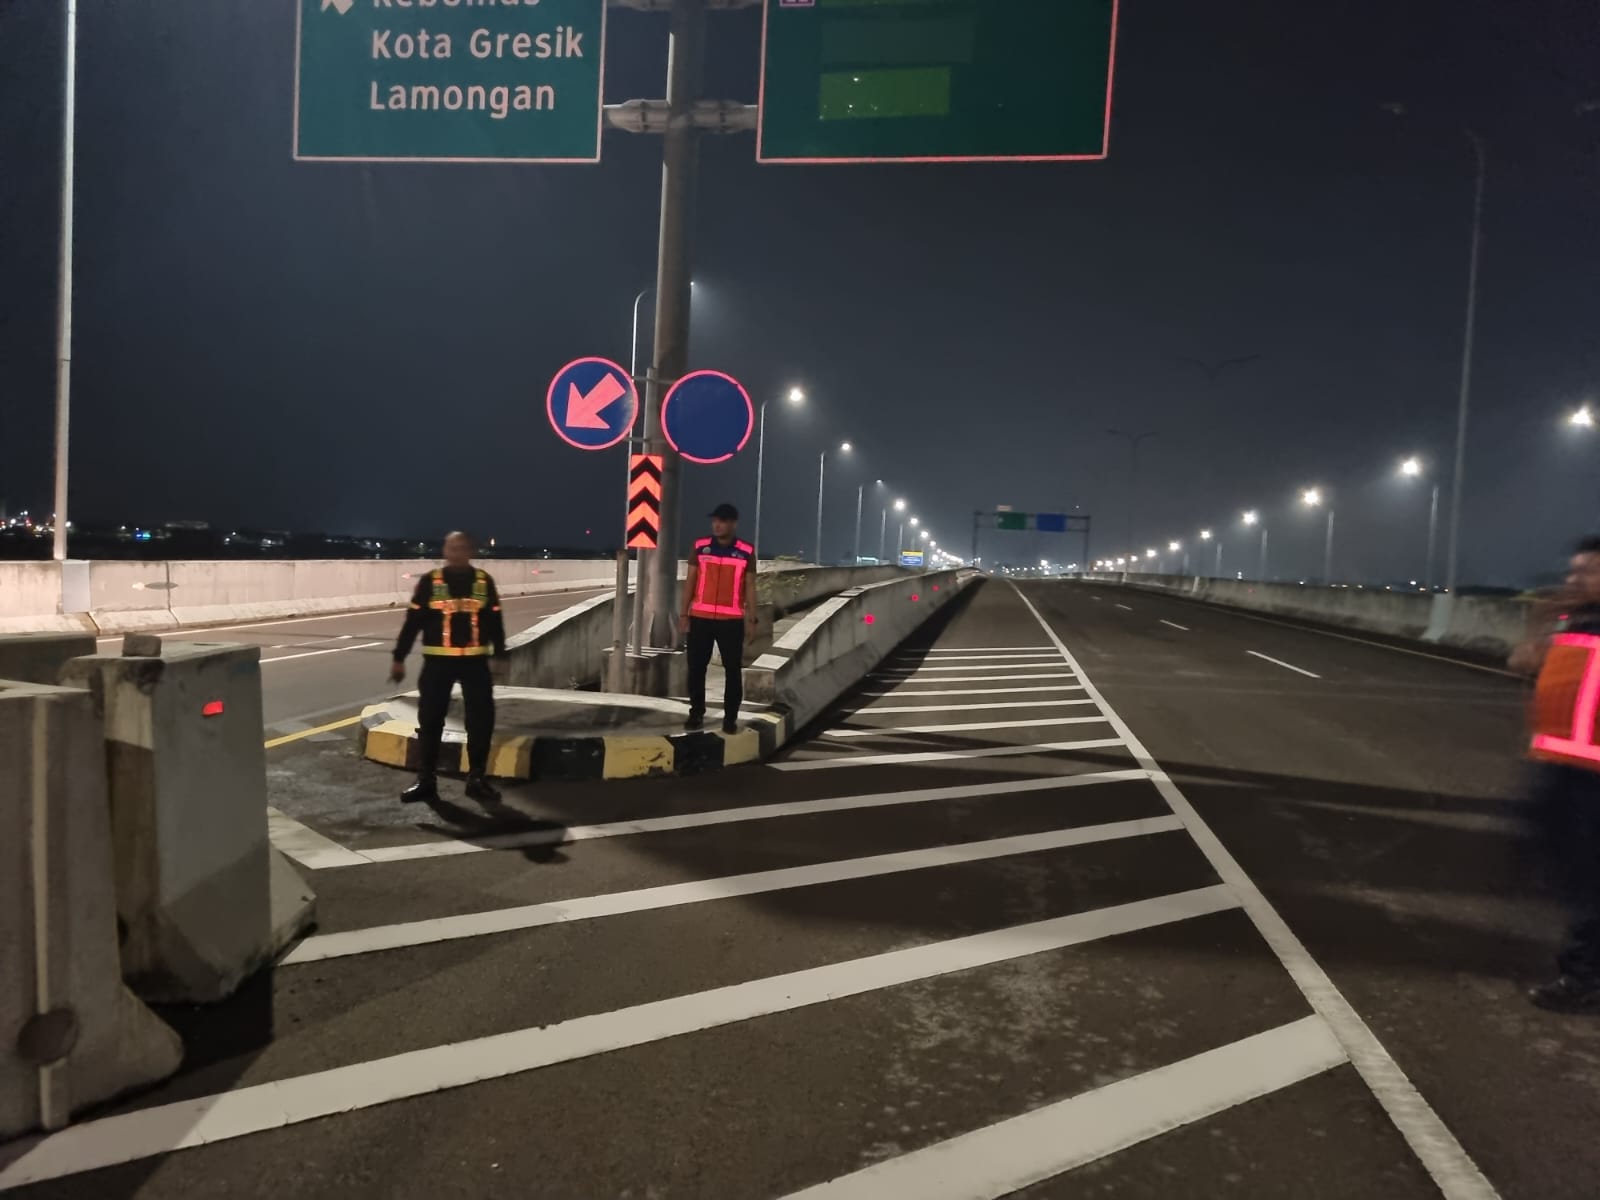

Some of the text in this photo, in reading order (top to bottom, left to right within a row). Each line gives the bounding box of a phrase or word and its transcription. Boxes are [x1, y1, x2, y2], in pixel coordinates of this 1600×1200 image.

[371, 25, 584, 59] Kota Gresik
[370, 81, 555, 119] Lamongan
